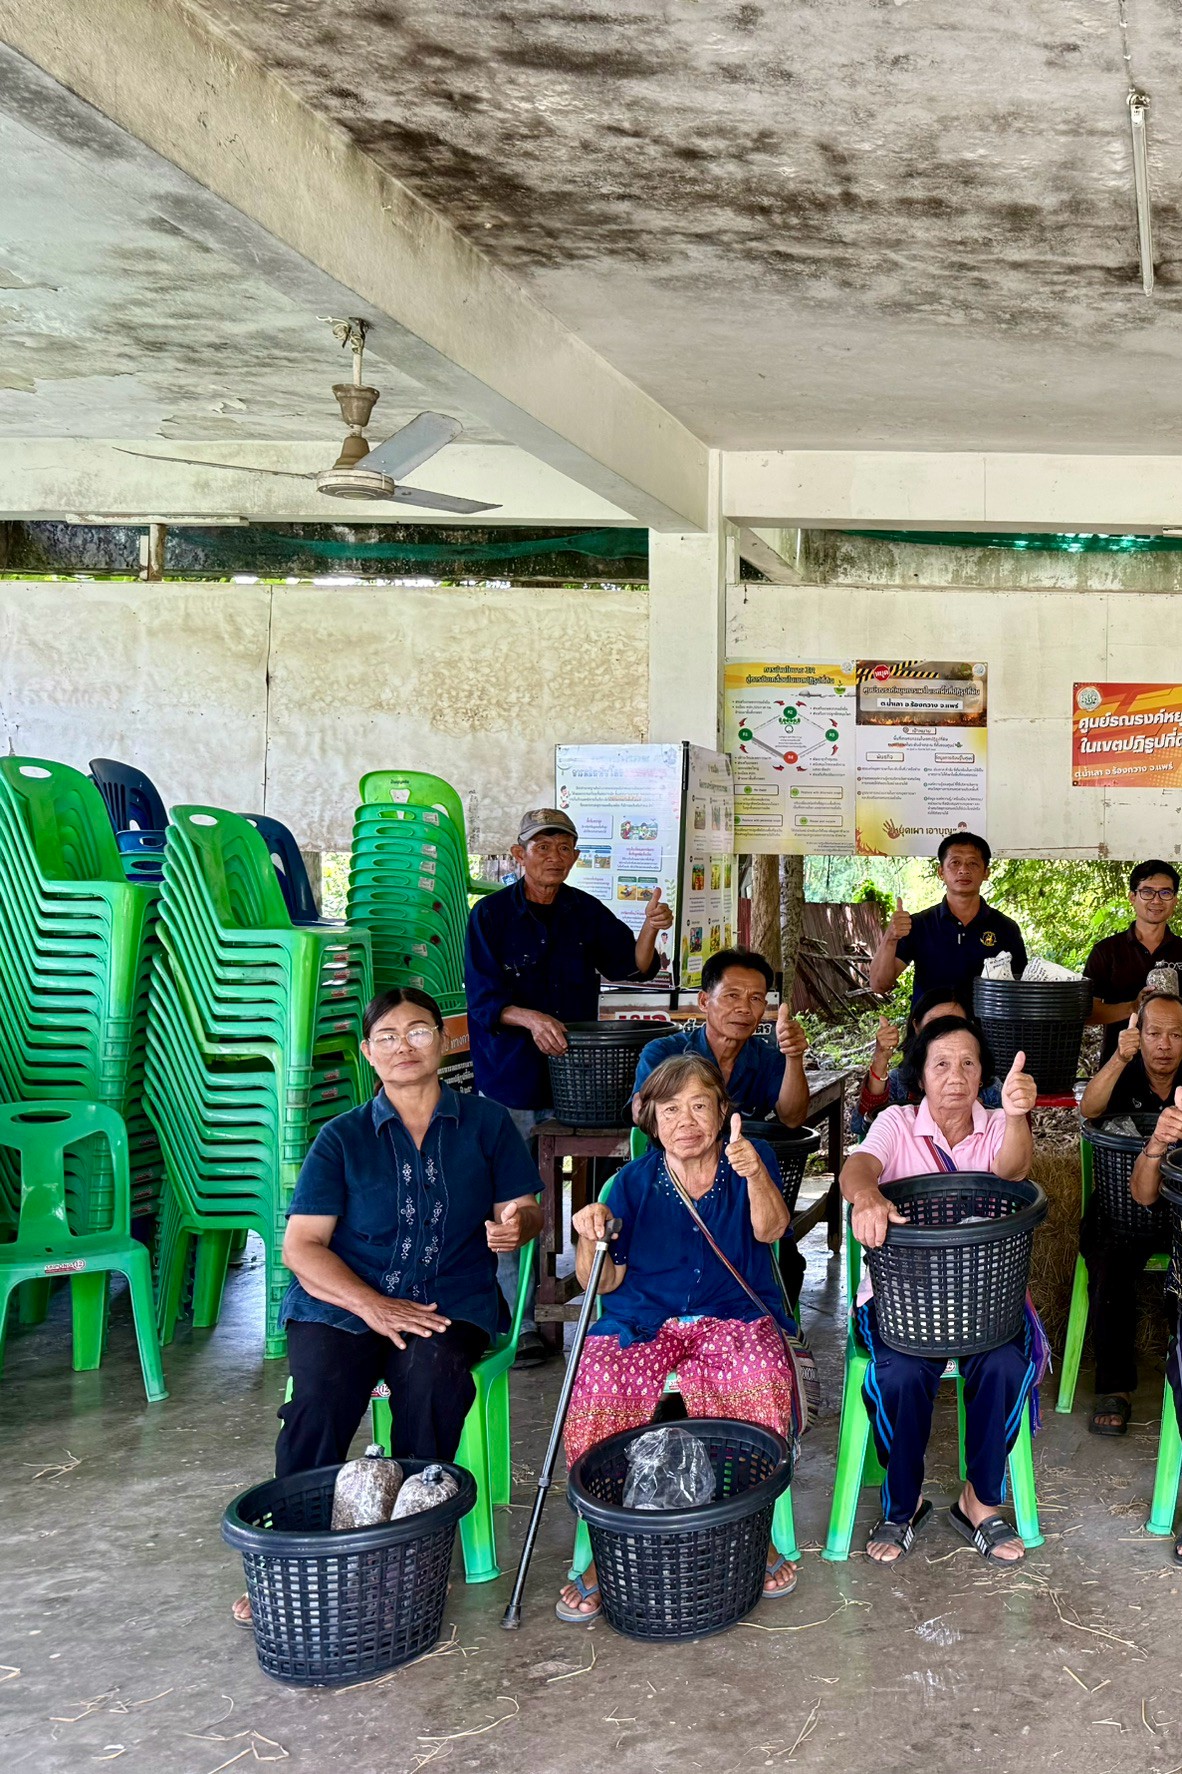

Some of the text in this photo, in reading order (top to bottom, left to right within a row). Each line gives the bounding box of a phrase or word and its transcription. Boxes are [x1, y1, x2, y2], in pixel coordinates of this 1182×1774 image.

[904, 700, 938, 708] อ.ร้องกวาง
[940, 701, 959, 709] จ.แพร่
[1105, 764, 1148, 775] อ.ร้องกวาง
[1150, 762, 1174, 772] จ.แพร่
